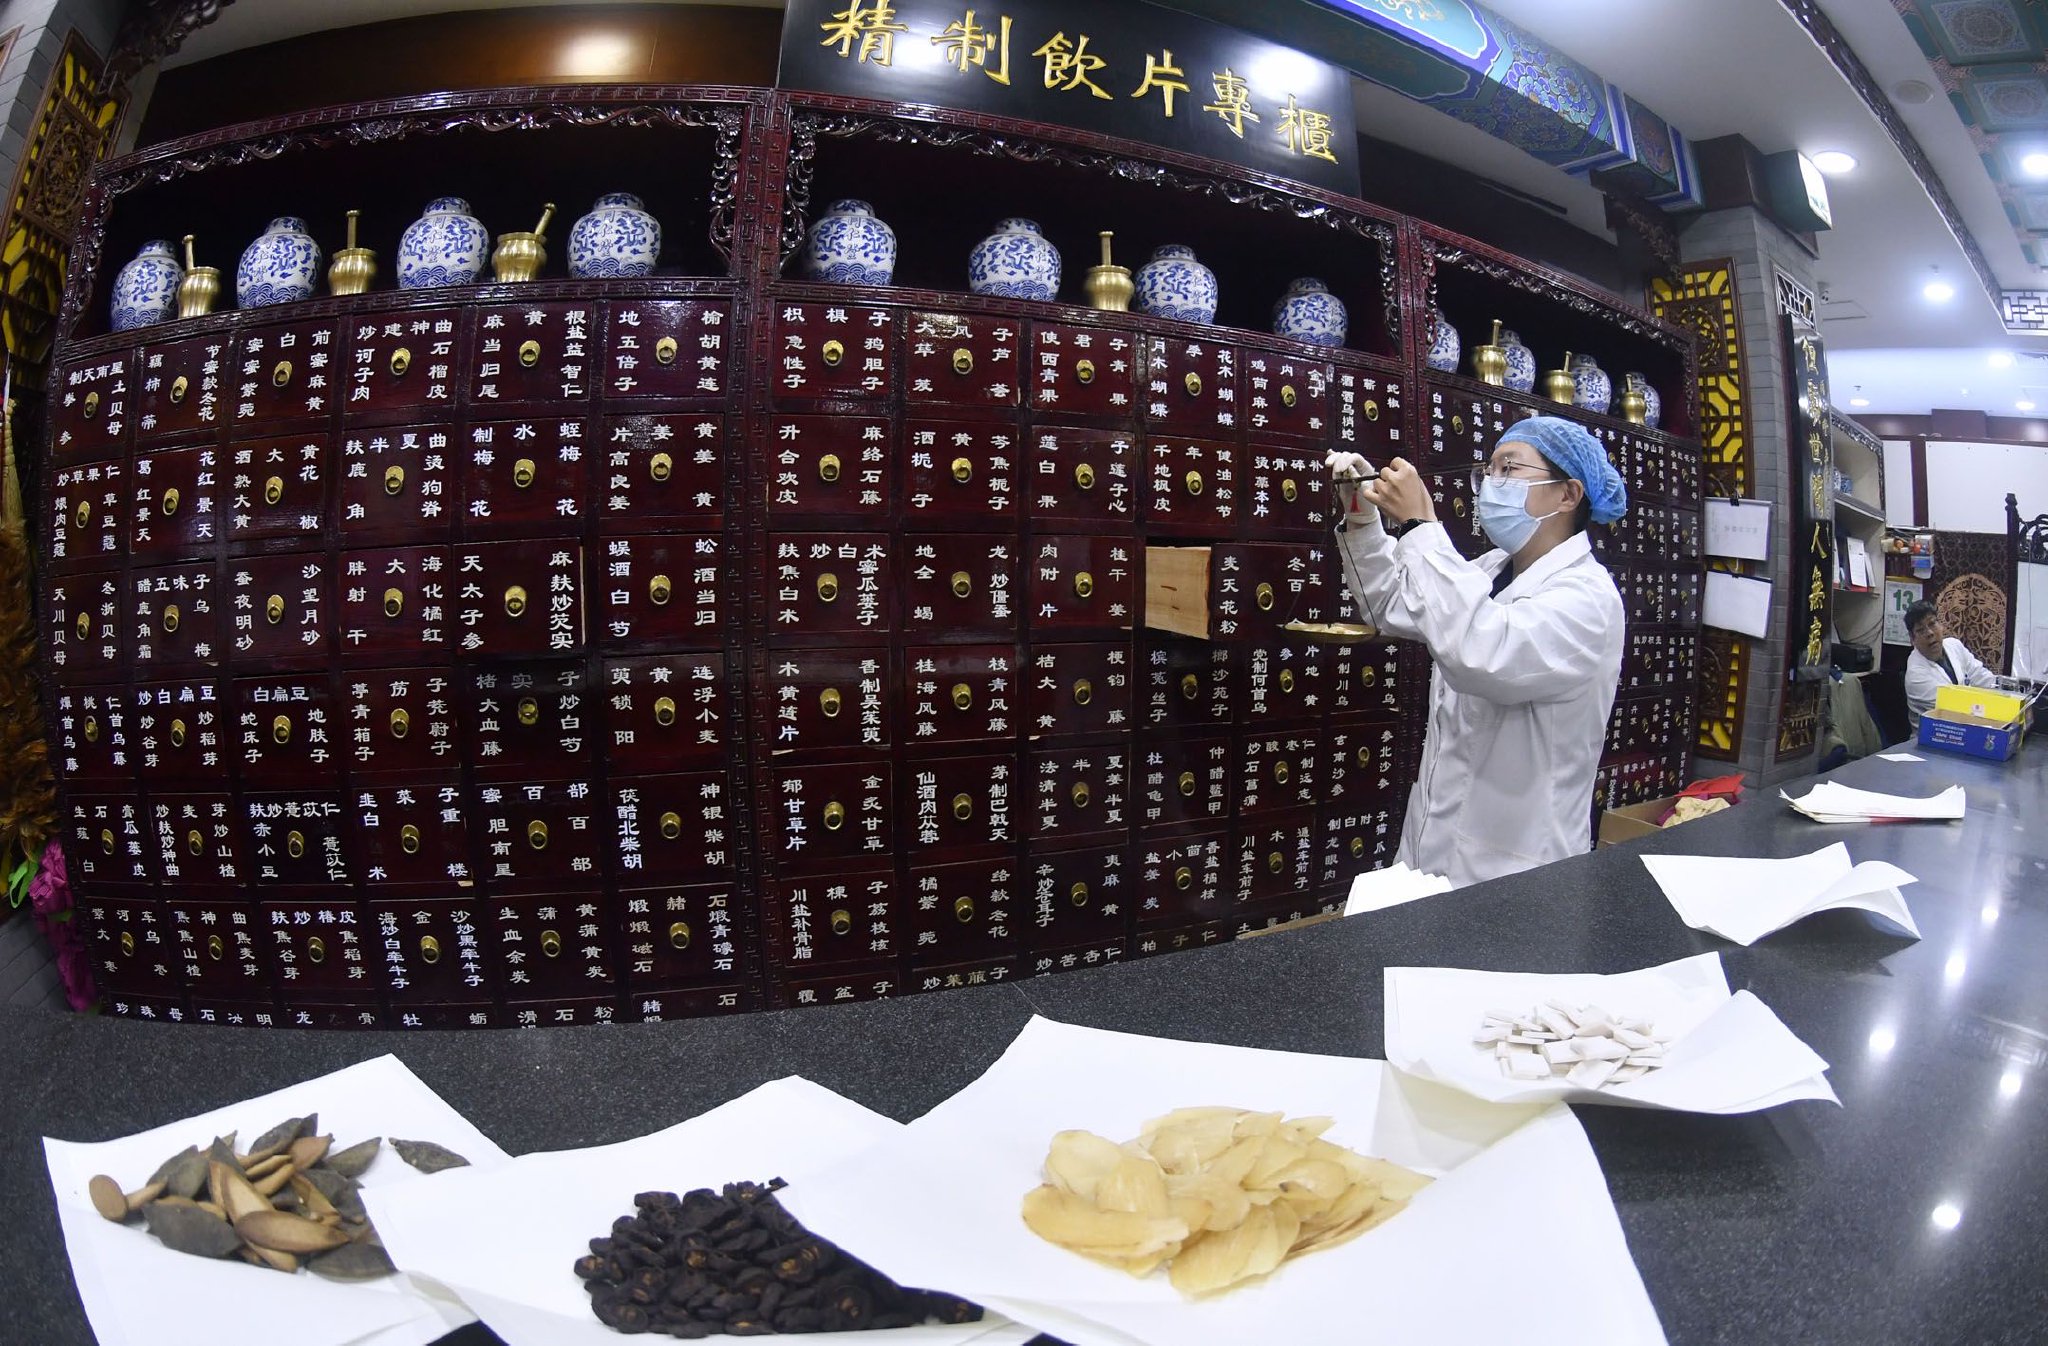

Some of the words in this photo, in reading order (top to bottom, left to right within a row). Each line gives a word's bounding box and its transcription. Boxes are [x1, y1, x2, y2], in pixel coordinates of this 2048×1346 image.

[246, 330, 331, 352] 蜜白前
[357, 319, 452, 341] 炒建神曲
[483, 311, 586, 328] 麻黄根
[915, 321, 1013, 341] 大风子
[1041, 331, 1128, 351] 使君子
[69, 361, 123, 385] 制天南星
[351, 349, 375, 401] 诃子肉
[427, 341, 452, 398] 石榴皮
[478, 339, 500, 398] 当归尾
[561, 325, 587, 397] 盐益智仁
[615, 336, 639, 391] 五倍子
[697, 334, 720, 391] 胡黄连
[783, 335, 806, 388] 急性子
[862, 337, 884, 393] 鸦胆子
[990, 348, 1011, 397] 芦荟
[1149, 336, 1237, 364] 月季花
[1251, 360, 1325, 379] 鸡内金
[142, 378, 161, 429] 柿蒂
[238, 360, 260, 418] 蜜紫菀
[306, 353, 328, 411] 蜜麻黄
[1039, 352, 1059, 402] 西青果
[1110, 360, 1128, 405] 青果
[1149, 356, 1168, 417] 木蝴蝶
[1217, 366, 1234, 425] 木蝴蝶
[107, 380, 126, 435] 土贝母
[473, 423, 581, 442] 制水蛭
[611, 422, 717, 442] 片姜黄
[1308, 385, 1325, 429] 丁香
[1341, 391, 1355, 441] 酒乌梢蛇
[1387, 397, 1400, 440] 椒目
[235, 445, 319, 464] 酒大黄
[346, 433, 446, 458] 麸半夏曲
[914, 432, 1010, 449] 酒黄芩
[1154, 445, 1232, 462] 千年健
[1254, 456, 1323, 472] 烫骨碎补
[57, 465, 120, 486] 炒草果仁
[233, 475, 251, 529] 熟大黄
[300, 465, 319, 529] 花椒
[346, 462, 367, 519] 鹿角
[421, 455, 444, 517] 烫狗脊
[470, 450, 495, 516] 梅花
[556, 446, 582, 515] 梅花
[608, 451, 630, 510] 高良姜
[692, 449, 716, 507] 姜黄
[776, 450, 799, 504] 合欢皮
[860, 447, 884, 504] 络石藤
[911, 453, 933, 507] 栀子
[988, 457, 1010, 510] 焦栀子
[1038, 460, 1057, 508] 白果
[1109, 463, 1128, 512] 莲子心
[1153, 464, 1171, 512] 地枫皮
[1216, 469, 1232, 517] 油松节
[1308, 480, 1322, 522] 甘松
[102, 493, 117, 551] 草豆蔻
[136, 488, 151, 541] 红景天
[197, 472, 215, 537] 红景天
[347, 556, 442, 575] 胖大海
[778, 543, 886, 559] 麸炒白术
[137, 574, 210, 592] 醋五味子
[609, 562, 631, 637] 酒白芍
[694, 568, 716, 625] 酒当归
[778, 565, 800, 623] 焦白术
[914, 565, 935, 620] 全蝎
[1039, 567, 1059, 617] 附片
[1109, 569, 1127, 616] 干姜
[1220, 579, 1239, 634] 天花粉
[1893, 589, 1914, 612] 13
[101, 602, 116, 659] 浙贝母
[137, 602, 151, 658] 鹿角霜
[194, 600, 211, 657] 乌梅
[235, 594, 253, 650] 夜明砂
[301, 588, 320, 645] 望月砂
[347, 587, 367, 644] 射干
[422, 584, 443, 642] 化橘红
[460, 583, 483, 649] 太子参
[550, 574, 574, 649] 麸炒芡实
[139, 686, 216, 705] 炒白扁豆
[860, 678, 881, 742] 制吴茱萸
[916, 682, 937, 735] 海风藤
[987, 678, 1008, 731] 青风藤
[1037, 676, 1056, 728] 大黄
[1251, 660, 1268, 713] 制何首乌
[1305, 666, 1319, 706] 地黄
[109, 713, 126, 765] 首乌藤
[198, 711, 218, 765] 炒稻芽
[241, 712, 262, 763] 蛇床子
[308, 709, 329, 762] 地肤子
[351, 704, 374, 761] 青葙子
[479, 699, 502, 755] 大血藤
[559, 695, 582, 752] 炒白芍
[611, 695, 634, 745] 锁阳
[694, 687, 718, 743] 浮小麦
[778, 686, 799, 741] 黄连片
[62, 716, 78, 771] 首乌藤
[141, 716, 159, 767] 炒谷芽
[359, 788, 459, 807] 韭菜子
[482, 783, 588, 803] 蜜百部
[1039, 780, 1058, 830] 清半夏
[1105, 774, 1123, 823] 姜半夏
[1244, 761, 1259, 806] 石菖蒲
[617, 804, 642, 868] 醋北柴胡
[702, 806, 724, 865] 银柴胡
[784, 799, 806, 851] 甘草片
[989, 783, 1009, 840] 制巴戟天
[124, 821, 146, 876] 瓜蒌皮
[159, 821, 179, 876] 麸炒神曲
[214, 824, 235, 877] 炒山楂
[254, 823, 278, 877] 赤小豆
[323, 837, 347, 880] 薏苡仁
[364, 812, 387, 880] 白术
[440, 808, 468, 877] 重楼
[488, 819, 515, 876] 胆南星
[568, 817, 591, 871] 百部
[1035, 878, 1054, 927] 炒苍耳子
[1201, 856, 1220, 900] 盐橘核
[178, 930, 201, 976] 焦山楂
[578, 924, 606, 978] 蒲黄炭
[630, 921, 653, 972] 煅磁石
[791, 904, 812, 959] 盐补骨脂
[868, 903, 889, 951] 荔枝核
[234, 932, 258, 976] 焦麦芽
[273, 931, 300, 979] 焦谷芽
[339, 931, 365, 978] 焦稻芽
[378, 924, 409, 988] 炒白牵牛子
[457, 924, 484, 986] 炒黑牵牛子
[503, 929, 530, 983] 血余炭
